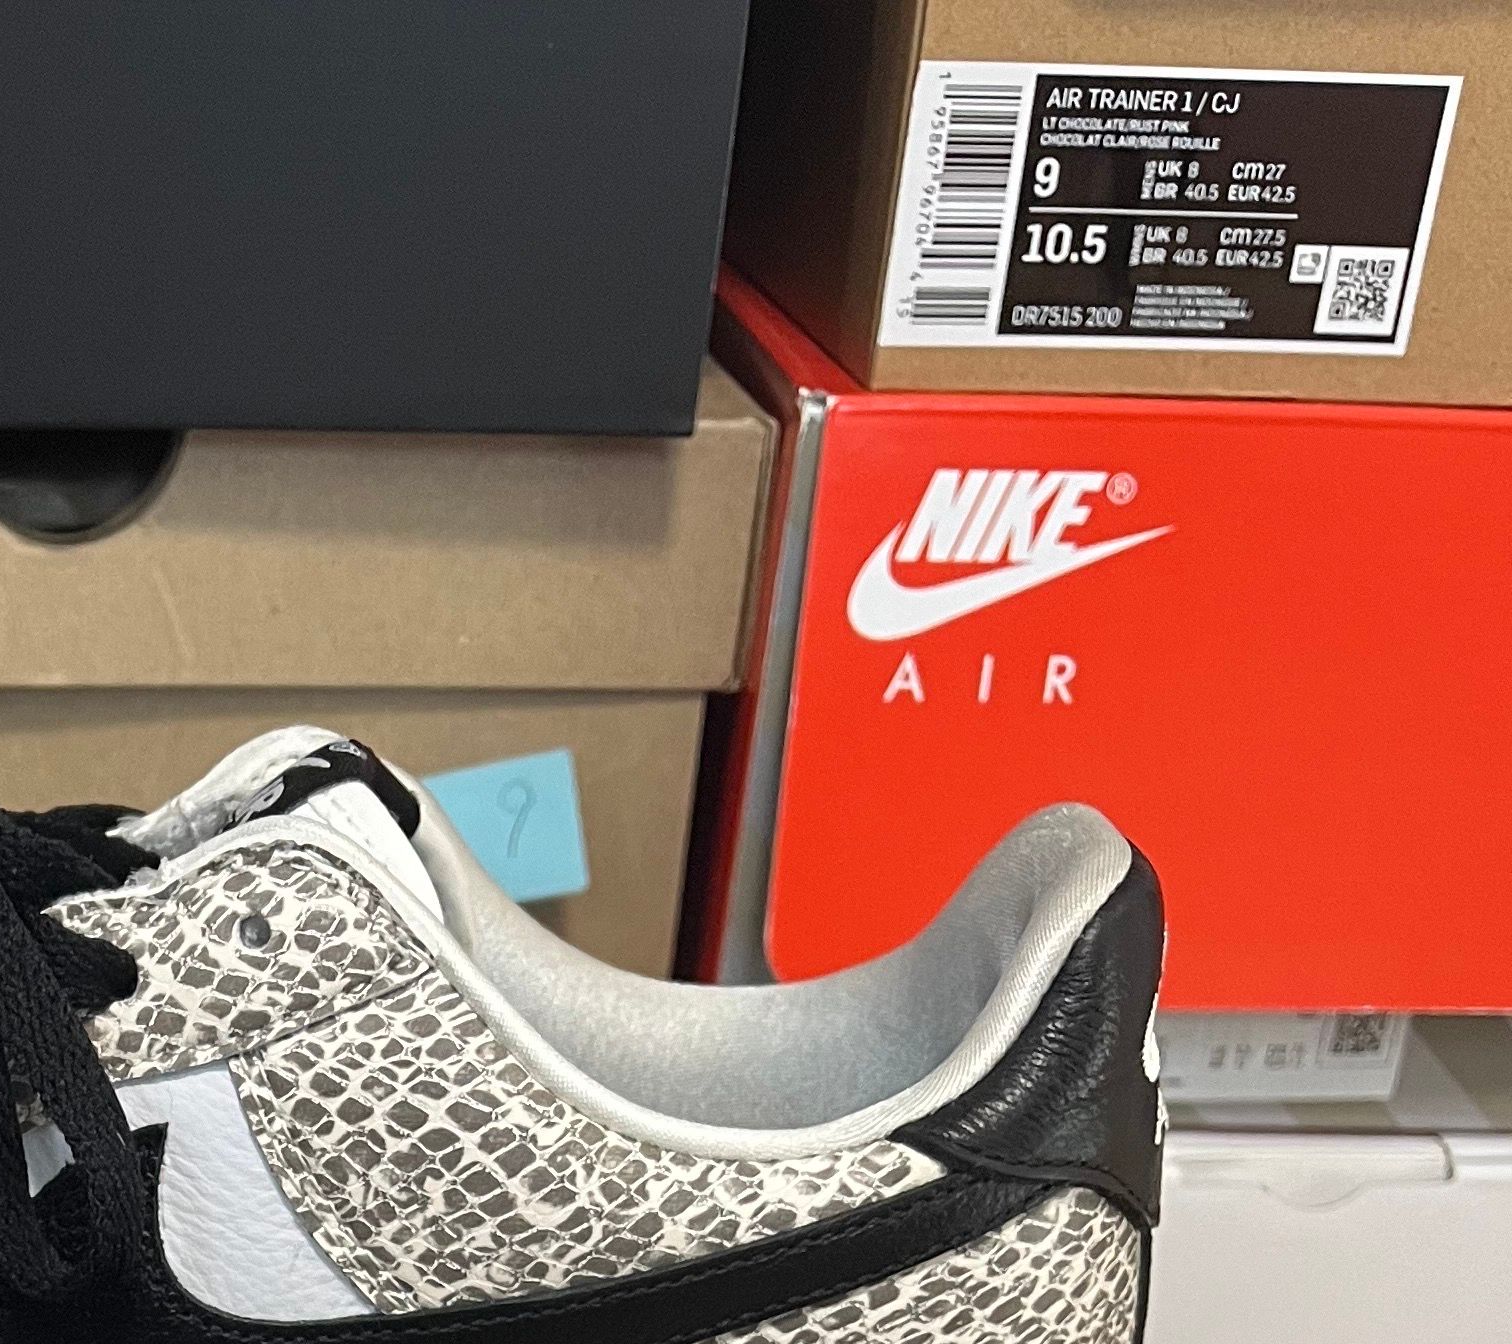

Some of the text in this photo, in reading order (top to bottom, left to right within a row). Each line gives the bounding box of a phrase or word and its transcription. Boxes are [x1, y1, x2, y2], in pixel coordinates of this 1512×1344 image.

[1046, 87, 1241, 117] AIR TRAINER 1 / CJ
[1042, 117, 1057, 130] LT
[1033, 156, 1061, 198] 9
[1158, 160, 1183, 178] UK
[1188, 161, 1200, 179] 8
[1184, 183, 1220, 200] 40.5
[1021, 222, 1108, 264] 10.5
[1146, 225, 1173, 243] UK
[1011, 304, 1083, 327] DR7515
[1085, 306, 1123, 327] 200
[895, 467, 1111, 564] NIKE
[882, 650, 1078, 705] AIR
